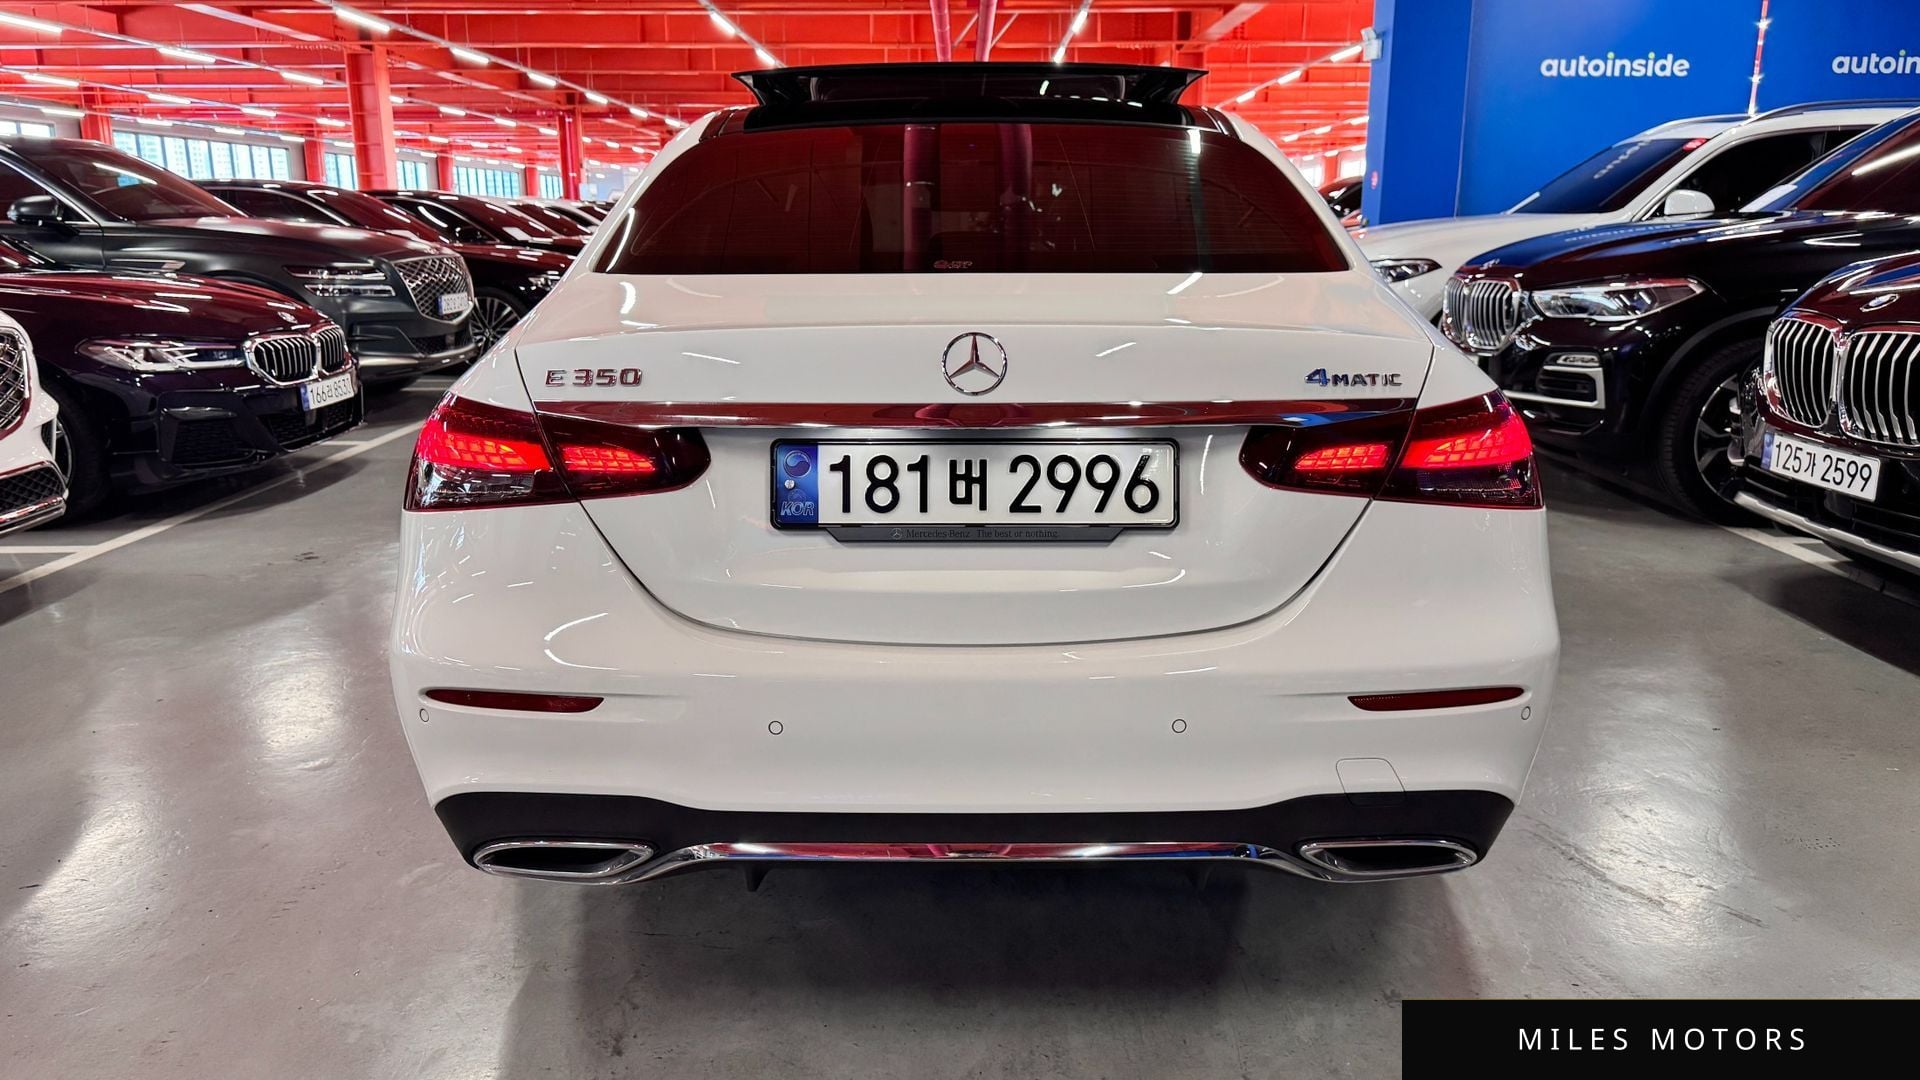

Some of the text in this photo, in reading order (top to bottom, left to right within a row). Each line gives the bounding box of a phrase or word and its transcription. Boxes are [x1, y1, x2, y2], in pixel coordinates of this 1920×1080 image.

[1540, 52, 1690, 78] autoinside
[545, 367, 643, 388] E 350
[1304, 367, 1402, 387] 4MATIC
[1775, 441, 1873, 493] 125가 2599
[829, 454, 1161, 514] 181버 2996
[780, 500, 815, 516] KOR
[976, 529, 991, 539] The
[994, 529, 1011, 539] best
[1014, 530, 1022, 539] or
